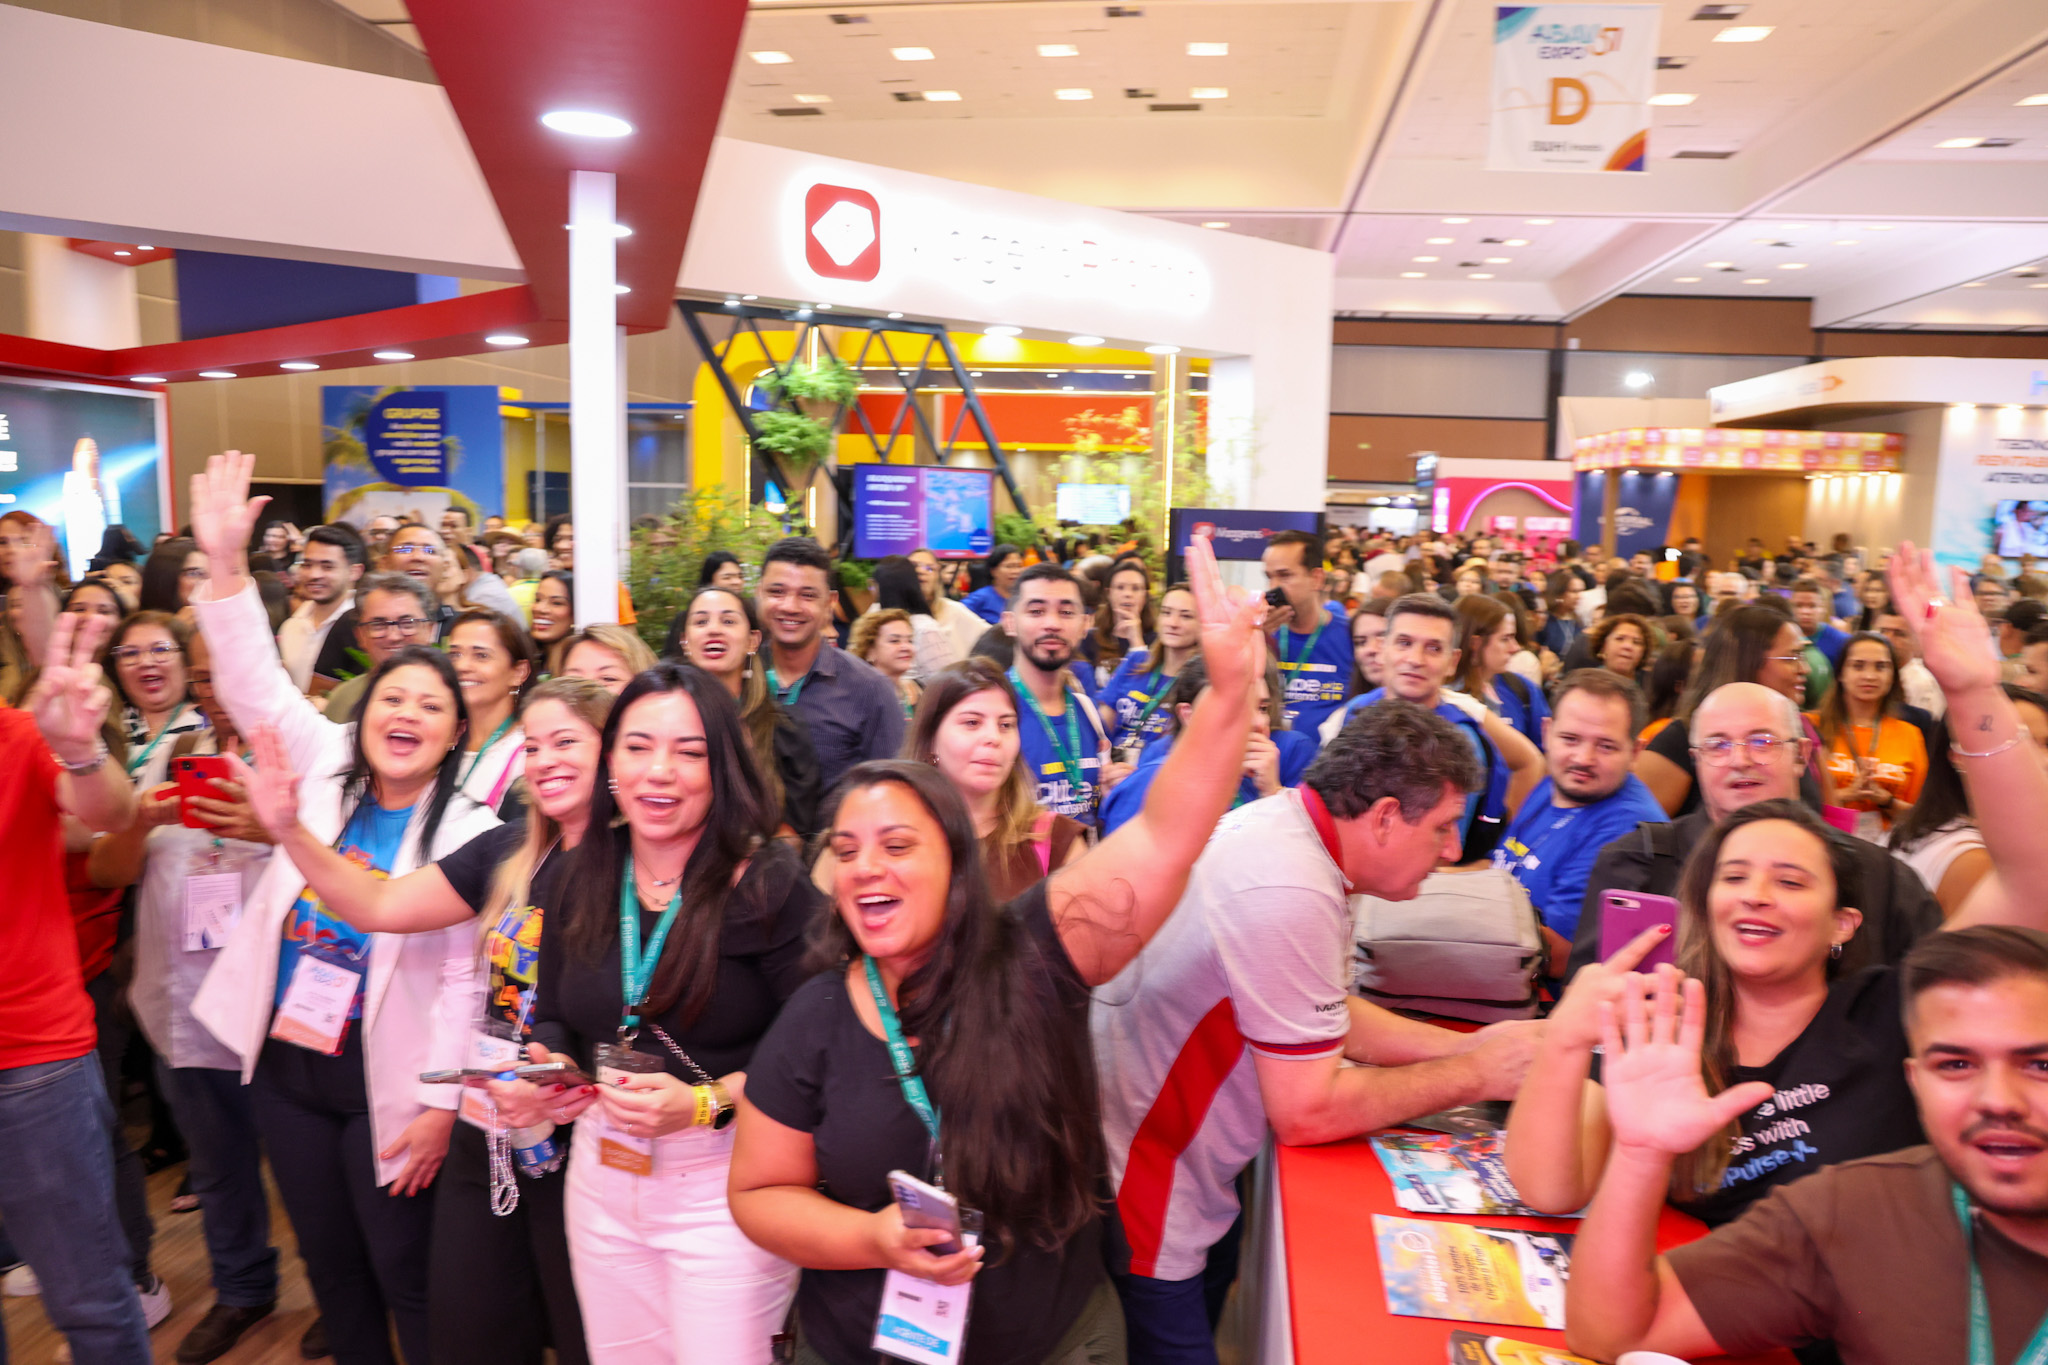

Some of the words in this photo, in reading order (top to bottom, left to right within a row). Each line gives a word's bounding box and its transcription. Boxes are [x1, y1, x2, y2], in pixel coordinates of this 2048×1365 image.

[1546, 77, 1591, 126] D
[1772, 1083, 1830, 1112] little
[1753, 1116, 1811, 1146] with
